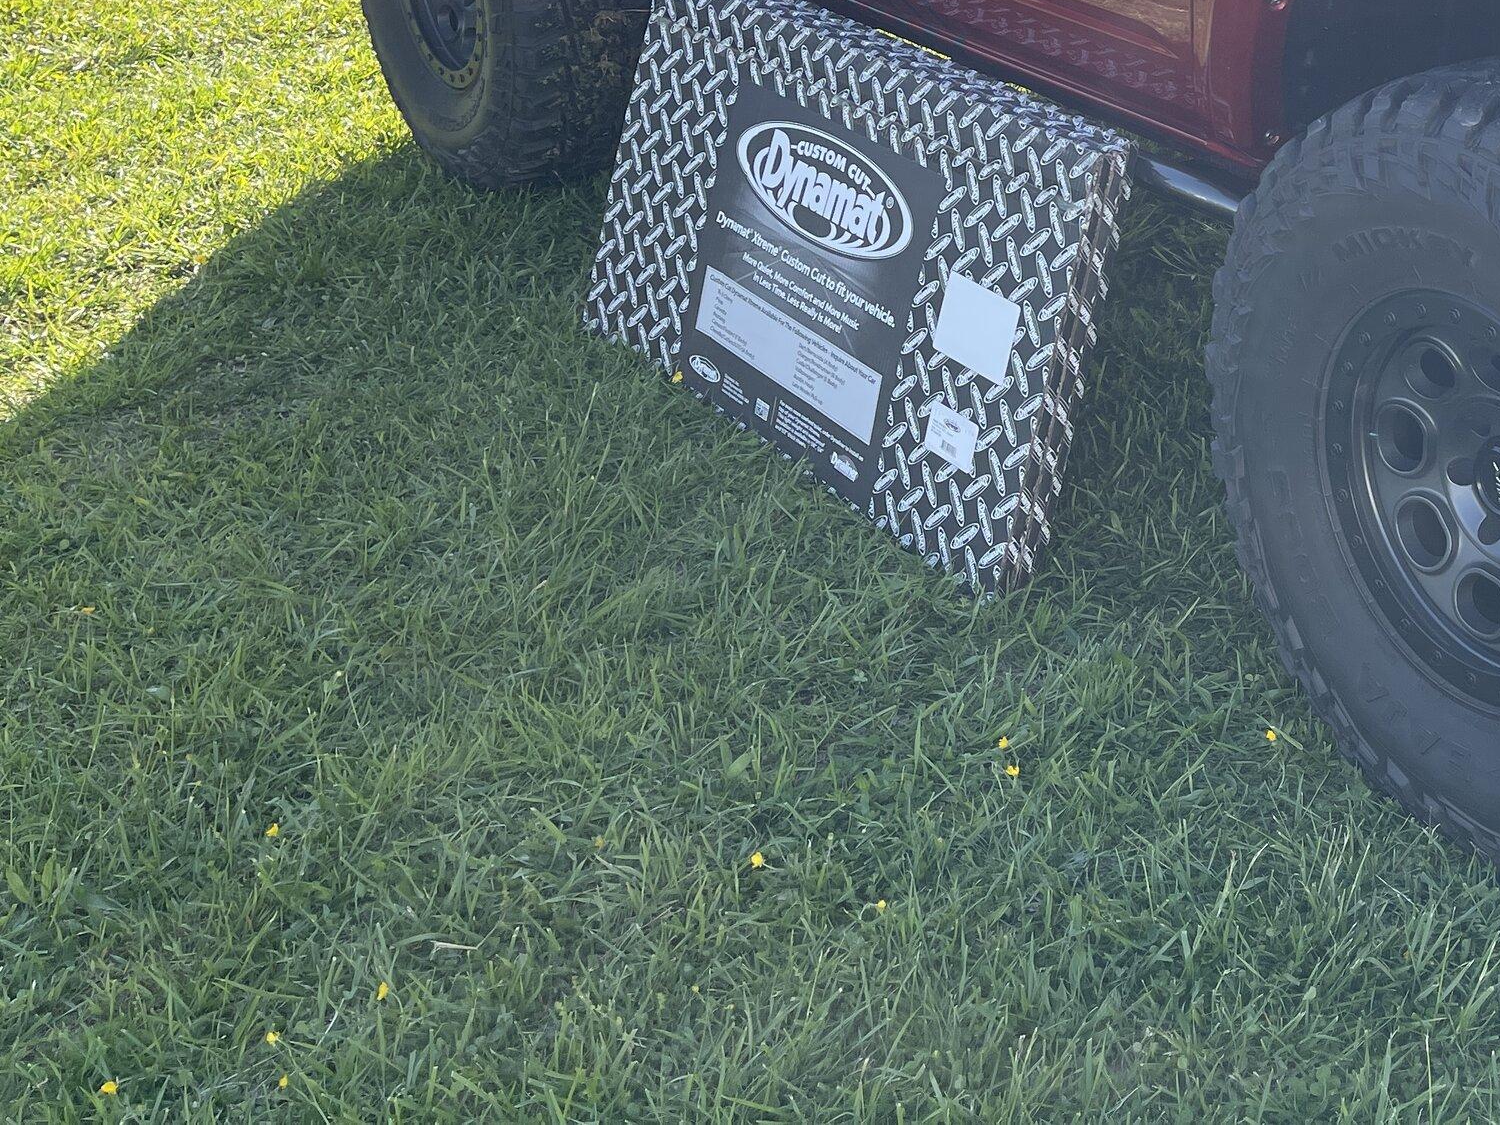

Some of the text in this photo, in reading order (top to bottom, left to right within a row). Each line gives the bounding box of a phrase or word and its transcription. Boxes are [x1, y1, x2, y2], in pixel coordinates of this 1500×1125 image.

[761, 128, 886, 245] Dynamat
[797, 140, 872, 191] CUSTOM CUT
[742, 252, 757, 267] More
[773, 273, 789, 288] More
[788, 280, 814, 303] Comfort
[813, 295, 826, 310] and
[825, 302, 841, 319] More
[840, 312, 860, 331] Music
[752, 272, 760, 283] In
[759, 275, 772, 291] Less
[786, 293, 800, 309] Less
[799, 301, 818, 321] Really
[781, 249, 811, 277] Custom
[811, 267, 827, 286] Cut
[826, 276, 836, 291] to
[835, 280, 846, 298] fit
[845, 290, 865, 308] your
[864, 300, 896, 328] vehicle.
